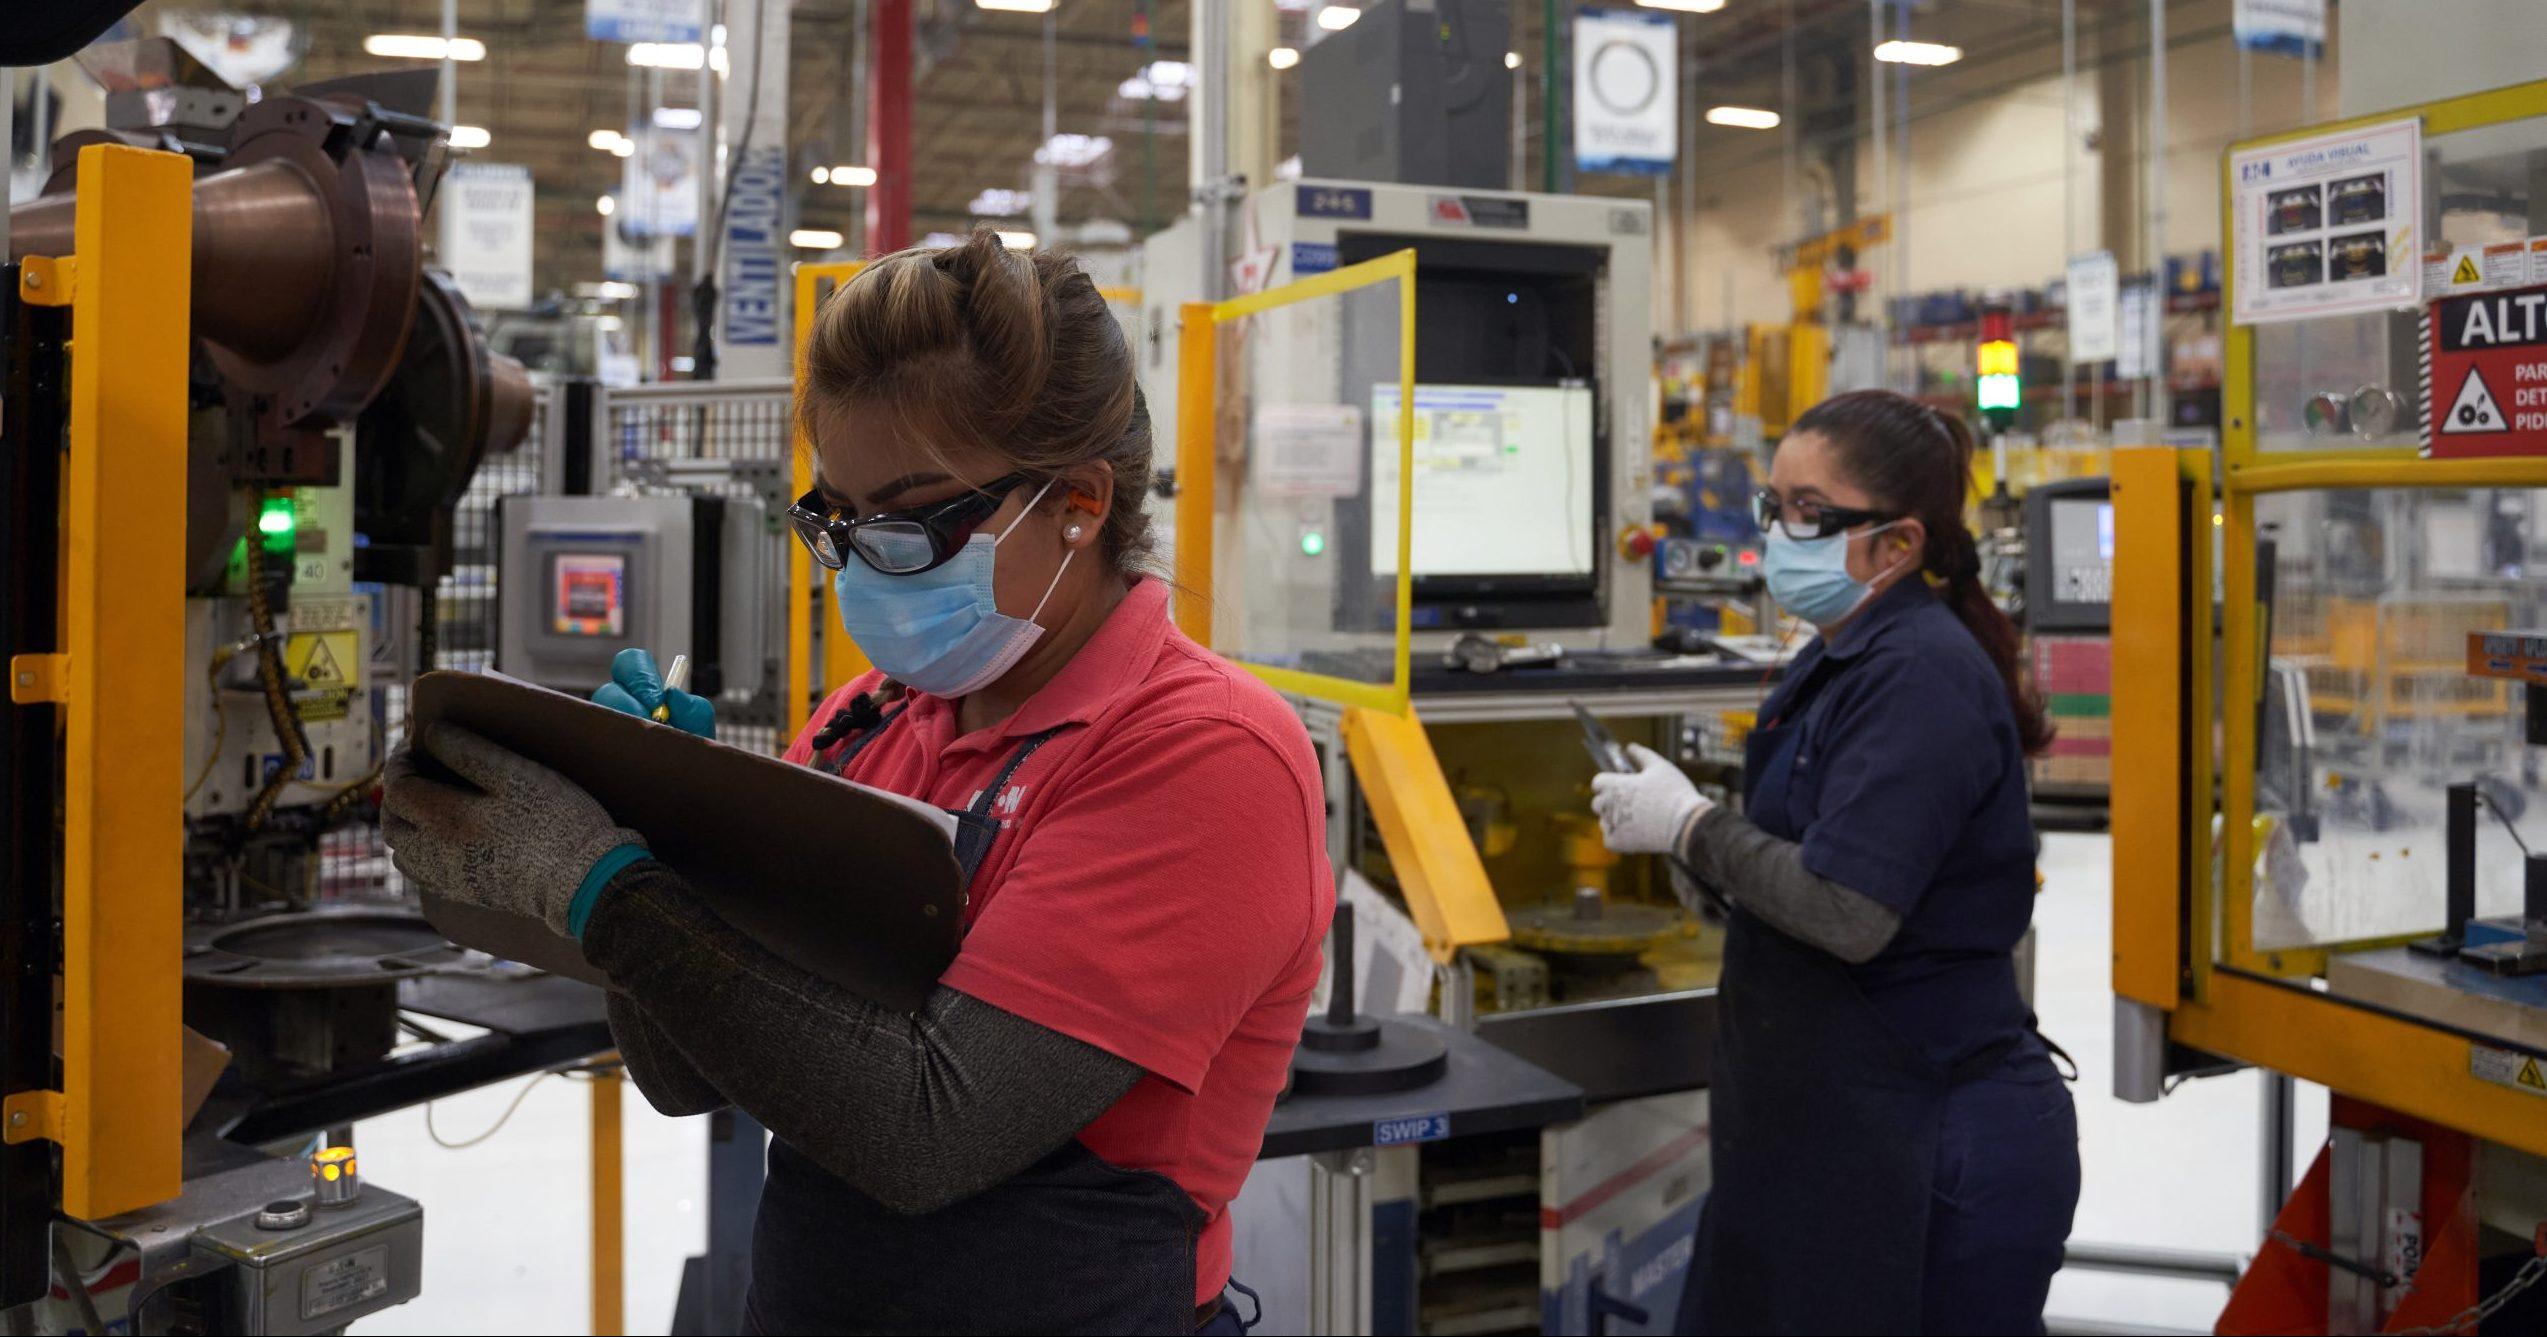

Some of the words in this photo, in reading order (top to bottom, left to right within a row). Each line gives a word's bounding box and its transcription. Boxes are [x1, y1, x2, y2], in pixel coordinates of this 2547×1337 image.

[2327, 143, 2370, 160] VISUAL
[2460, 294, 2547, 347] ALT
[1380, 1119, 1430, 1142] SWIP
[1435, 1117, 1447, 1139] 3
